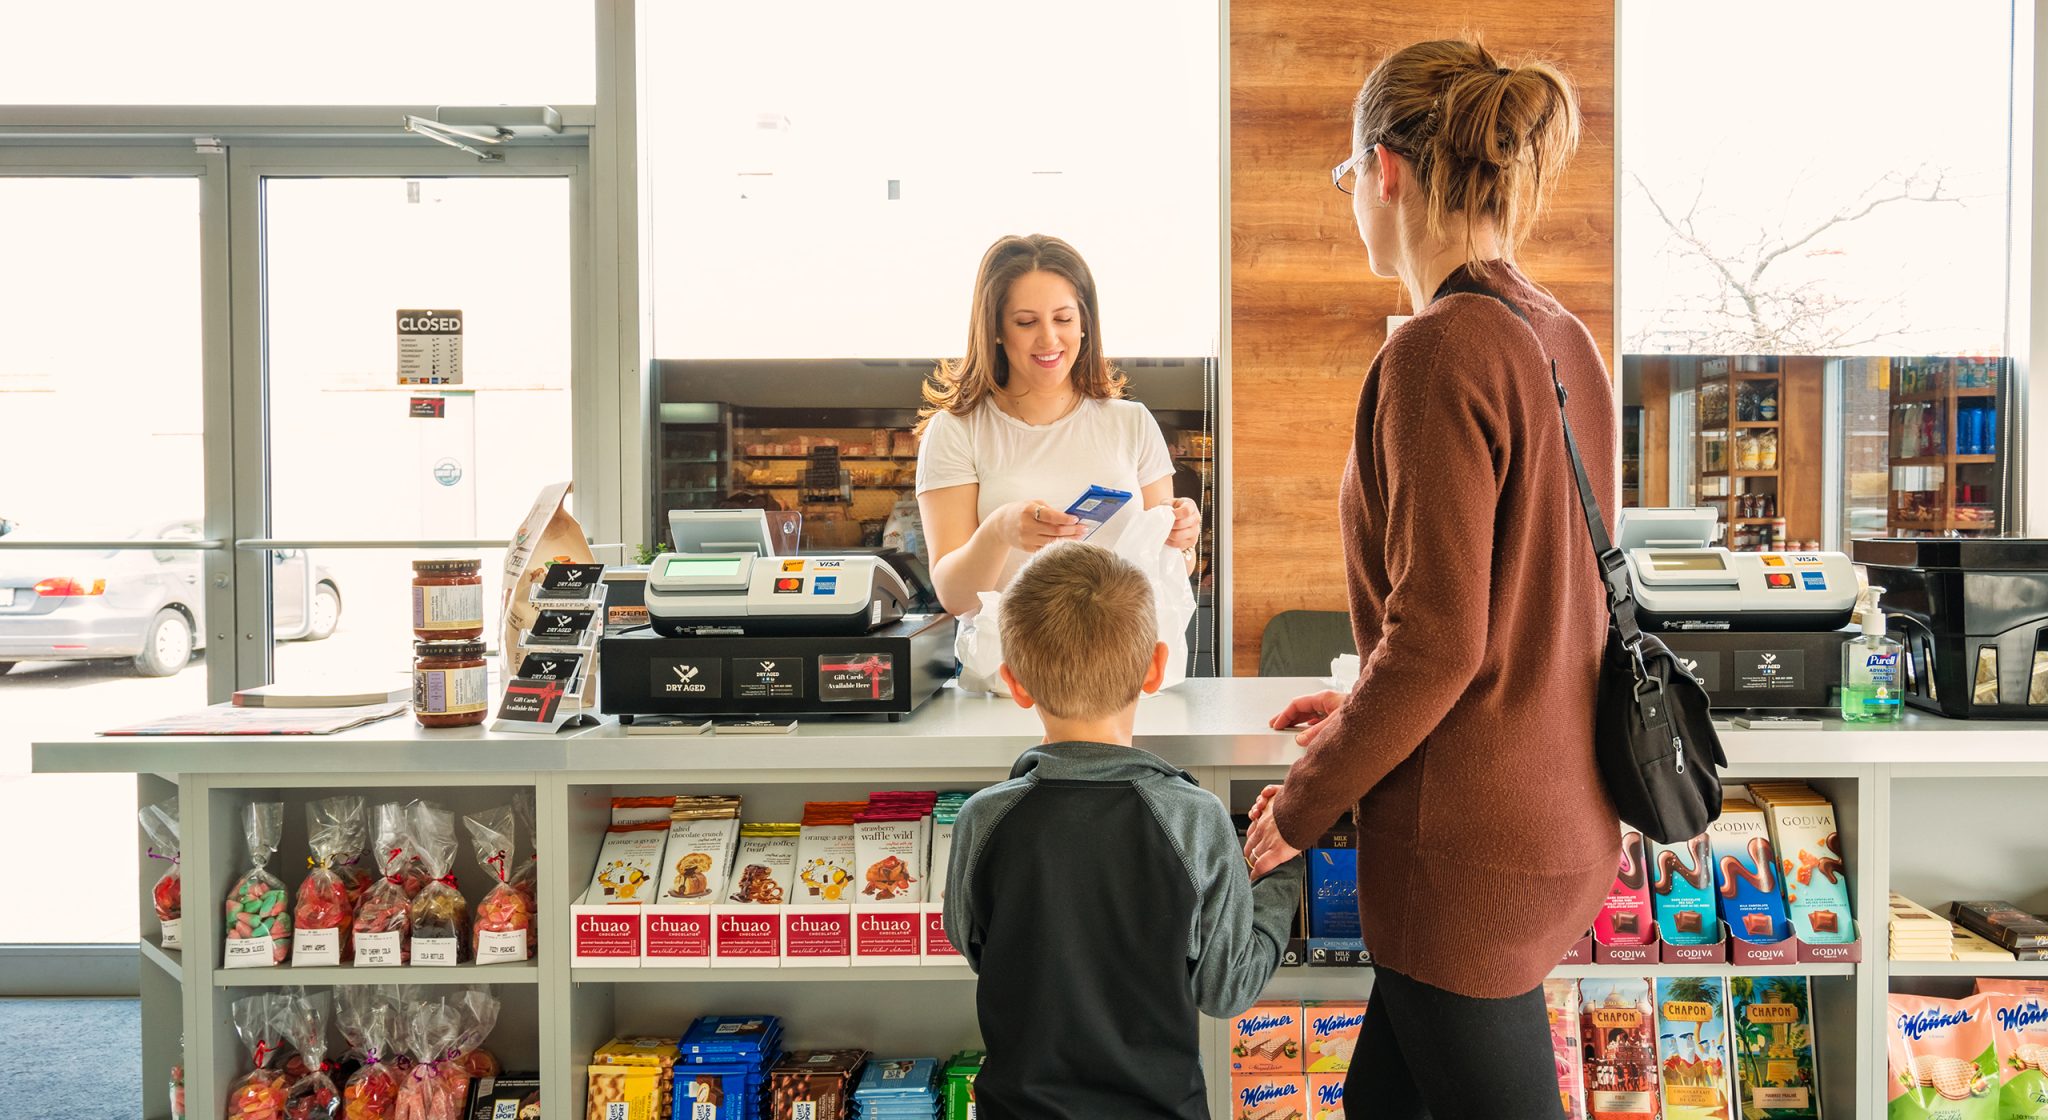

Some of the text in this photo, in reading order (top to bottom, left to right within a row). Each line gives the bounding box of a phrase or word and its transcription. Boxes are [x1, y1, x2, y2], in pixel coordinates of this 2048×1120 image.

[398, 318, 460, 331] CLOSED
[1870, 656, 1896, 664] Purell
[1714, 822, 1762, 832] GODIVA
[1782, 816, 1831, 826] GODIVA
[861, 830, 914, 840] waffle wild
[581, 916, 630, 932] chuao
[651, 916, 700, 932] chuao
[721, 916, 770, 932] chuao
[791, 916, 840, 932] chuao
[862, 915, 911, 931] chuao
[1597, 1012, 1636, 1021] CHAPON
[1669, 1005, 1707, 1015] CHAPON
[1752, 1006, 1791, 1017] CHAPON
[1238, 1015, 1293, 1036] Manner
[1897, 1008, 1974, 1040] Manner
[1240, 1084, 1298, 1107] Manner
